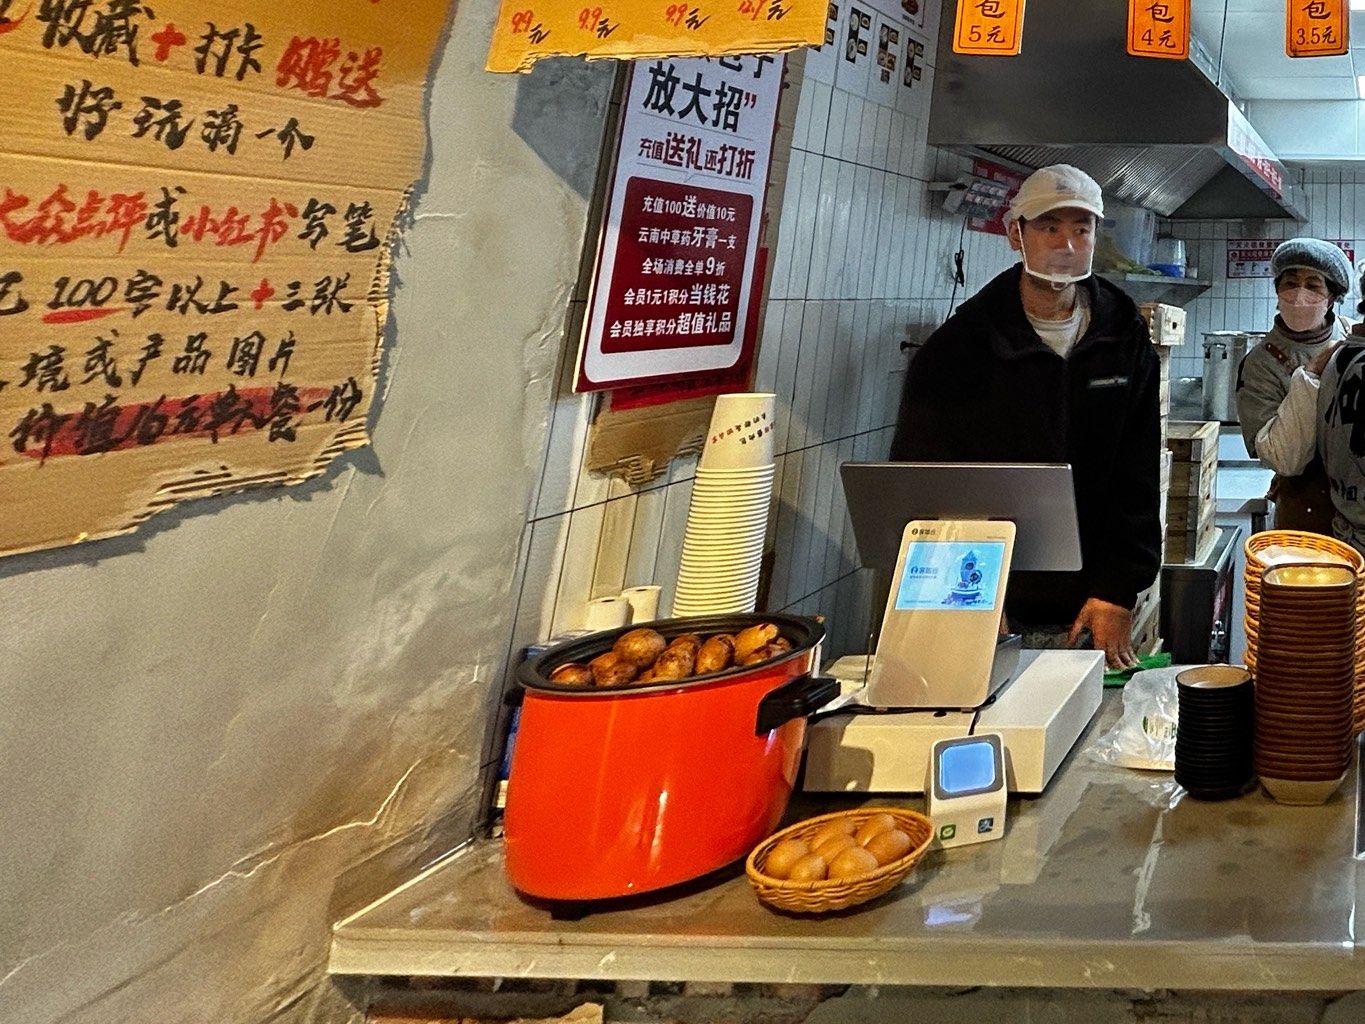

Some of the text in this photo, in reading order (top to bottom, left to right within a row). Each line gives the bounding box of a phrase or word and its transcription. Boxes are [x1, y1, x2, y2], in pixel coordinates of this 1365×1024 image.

[968, 24, 1006, 45] 5元
[1141, 29, 1176, 48] 4元
[1296, 26, 1336, 46] 3.5元
[639, 131, 756, 180] 充值送礼还打折
[641, 194, 737, 223] 充值100送价值10元
[638, 225, 737, 250] 云南中草药牙膏一支
[641, 255, 727, 277] 全场消费全单9折
[623, 282, 730, 306] 会员1元1积分当钱花
[610, 311, 732, 338] 会员独享积分超值礼品
[0, 329, 298, 393] 境或产品图片
